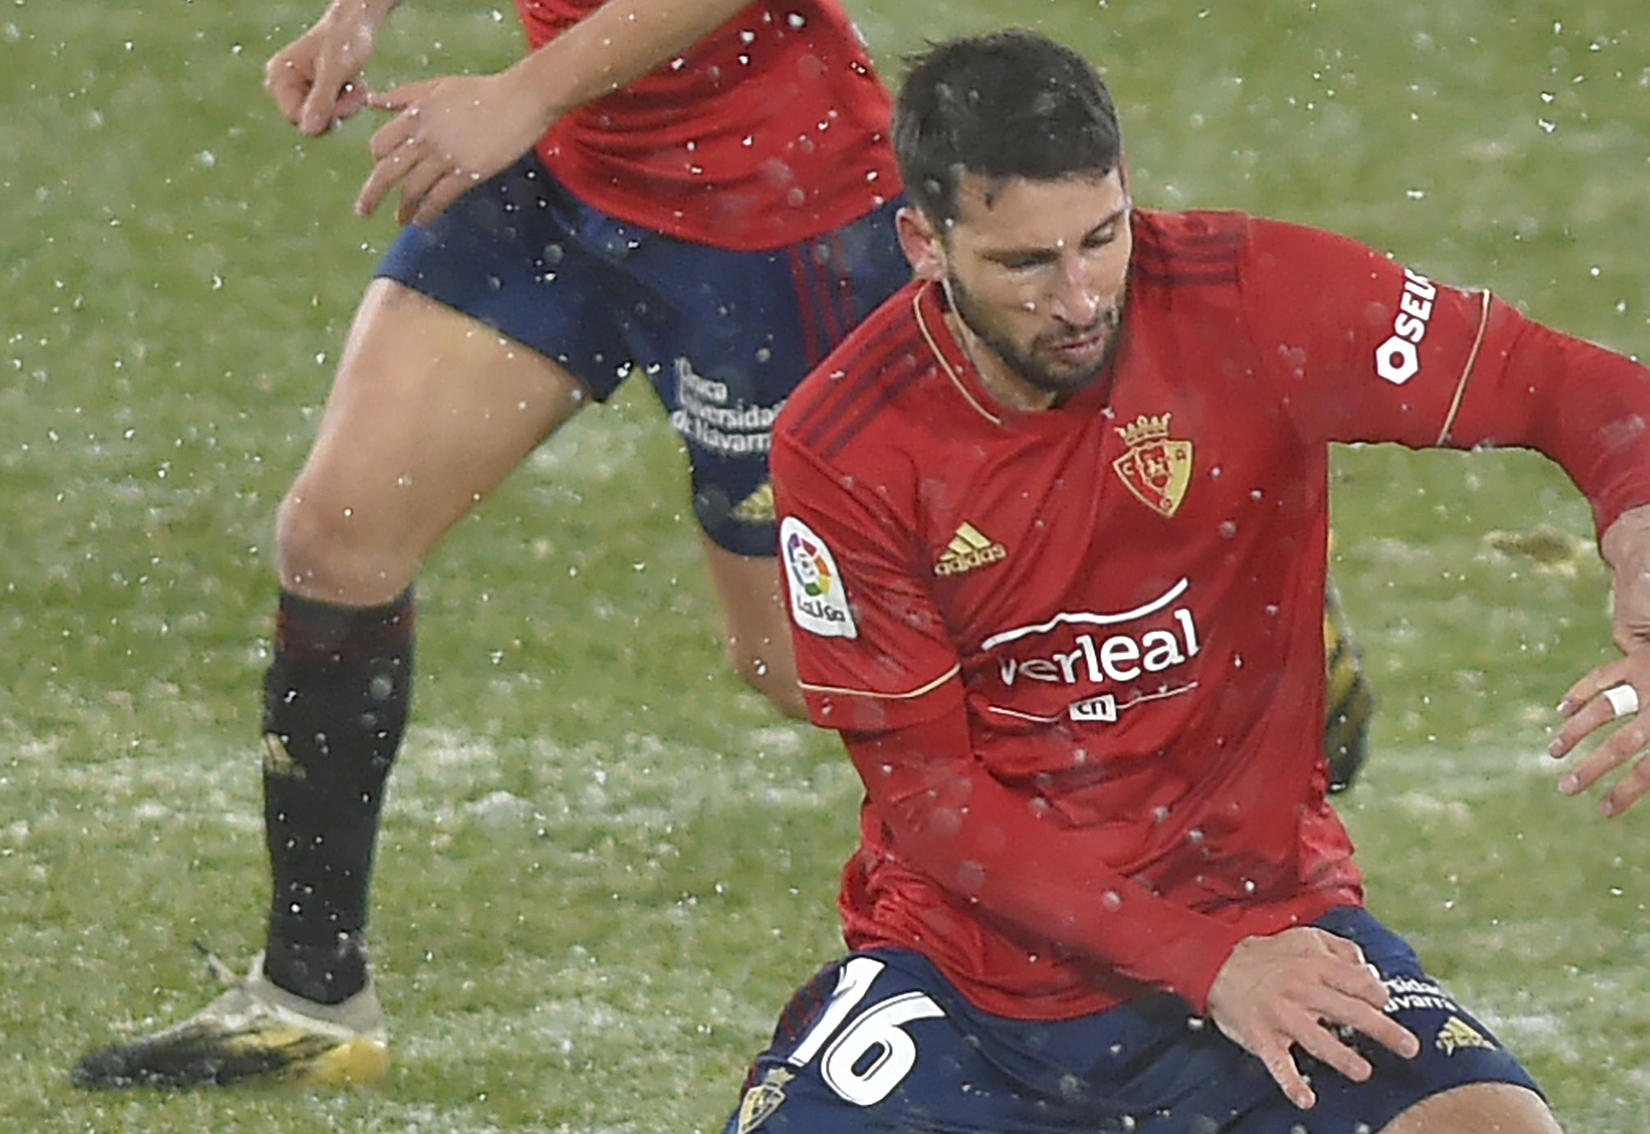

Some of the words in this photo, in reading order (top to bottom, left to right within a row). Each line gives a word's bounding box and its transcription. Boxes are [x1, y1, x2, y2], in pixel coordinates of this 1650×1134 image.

[935, 543, 1007, 575] adidas
[797, 595, 846, 622] LaLiga
[999, 608, 1201, 686] verleal
[787, 956, 947, 1107] 16
